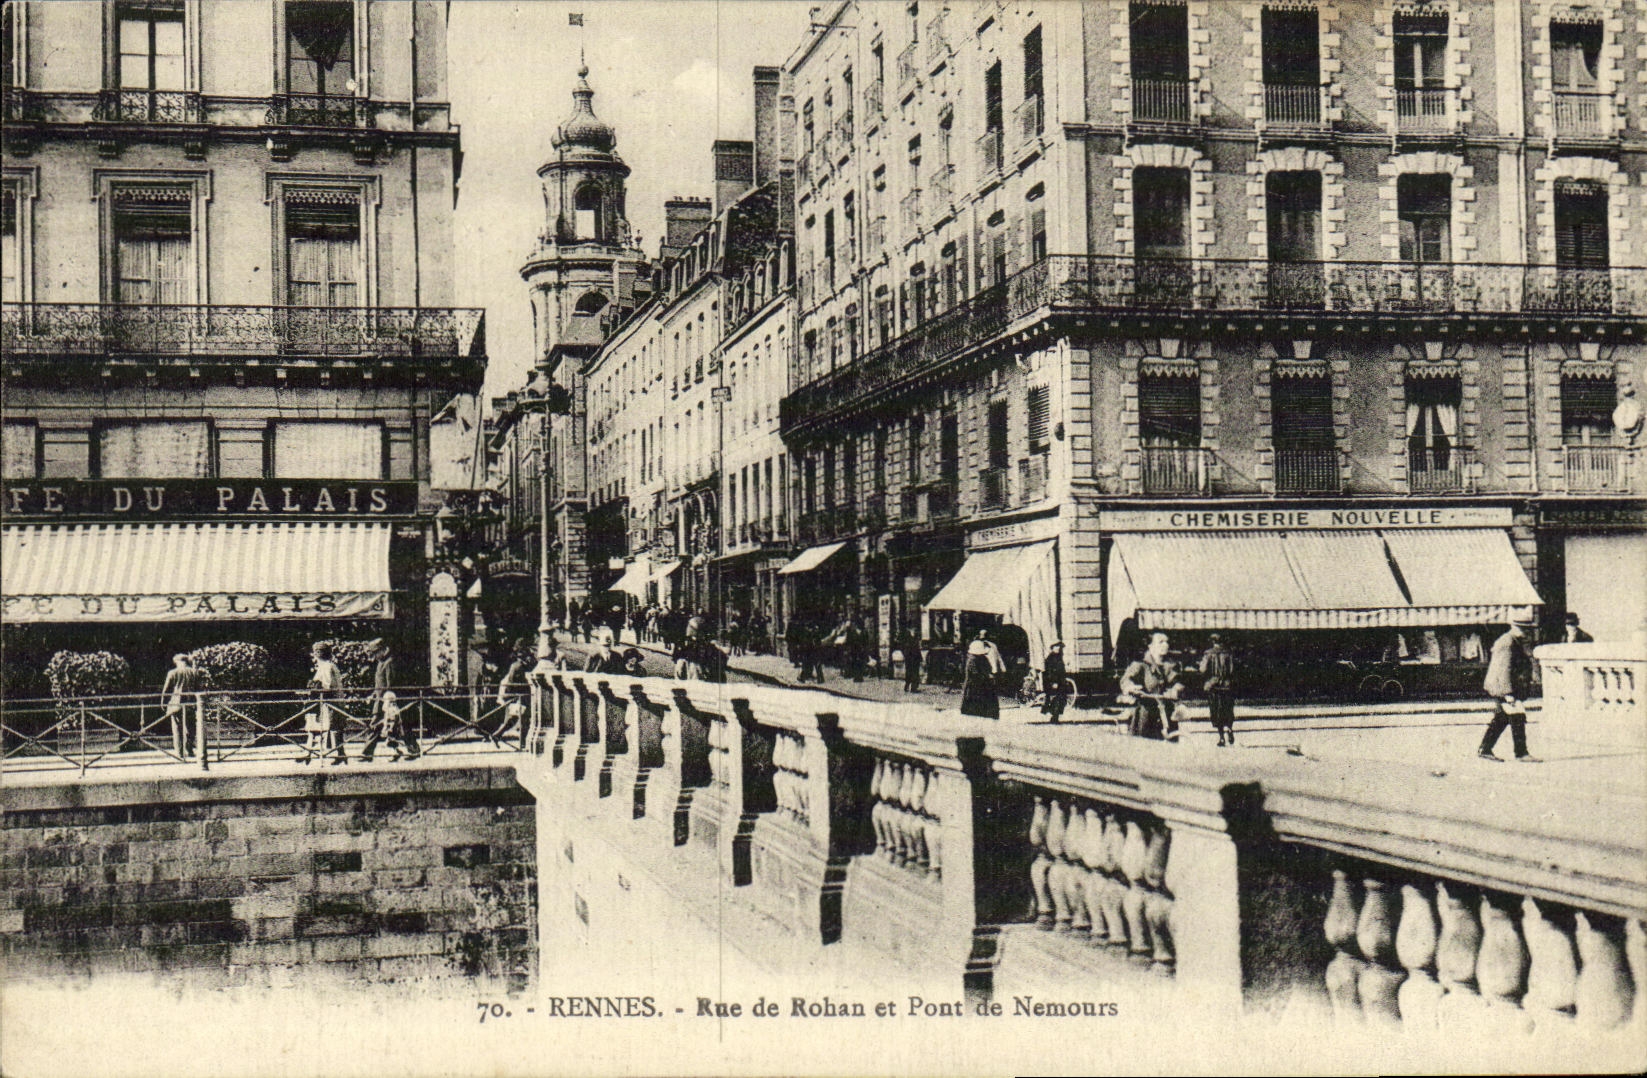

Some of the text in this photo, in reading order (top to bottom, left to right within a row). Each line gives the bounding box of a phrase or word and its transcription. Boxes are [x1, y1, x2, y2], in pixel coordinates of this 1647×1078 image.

[112, 487, 165, 512] DU
[216, 487, 388, 512] PALAIS
[1170, 510, 1442, 527] CHEMISERIE NOUVELLE
[81, 597, 140, 615] DU
[166, 595, 337, 614] PALAIS
